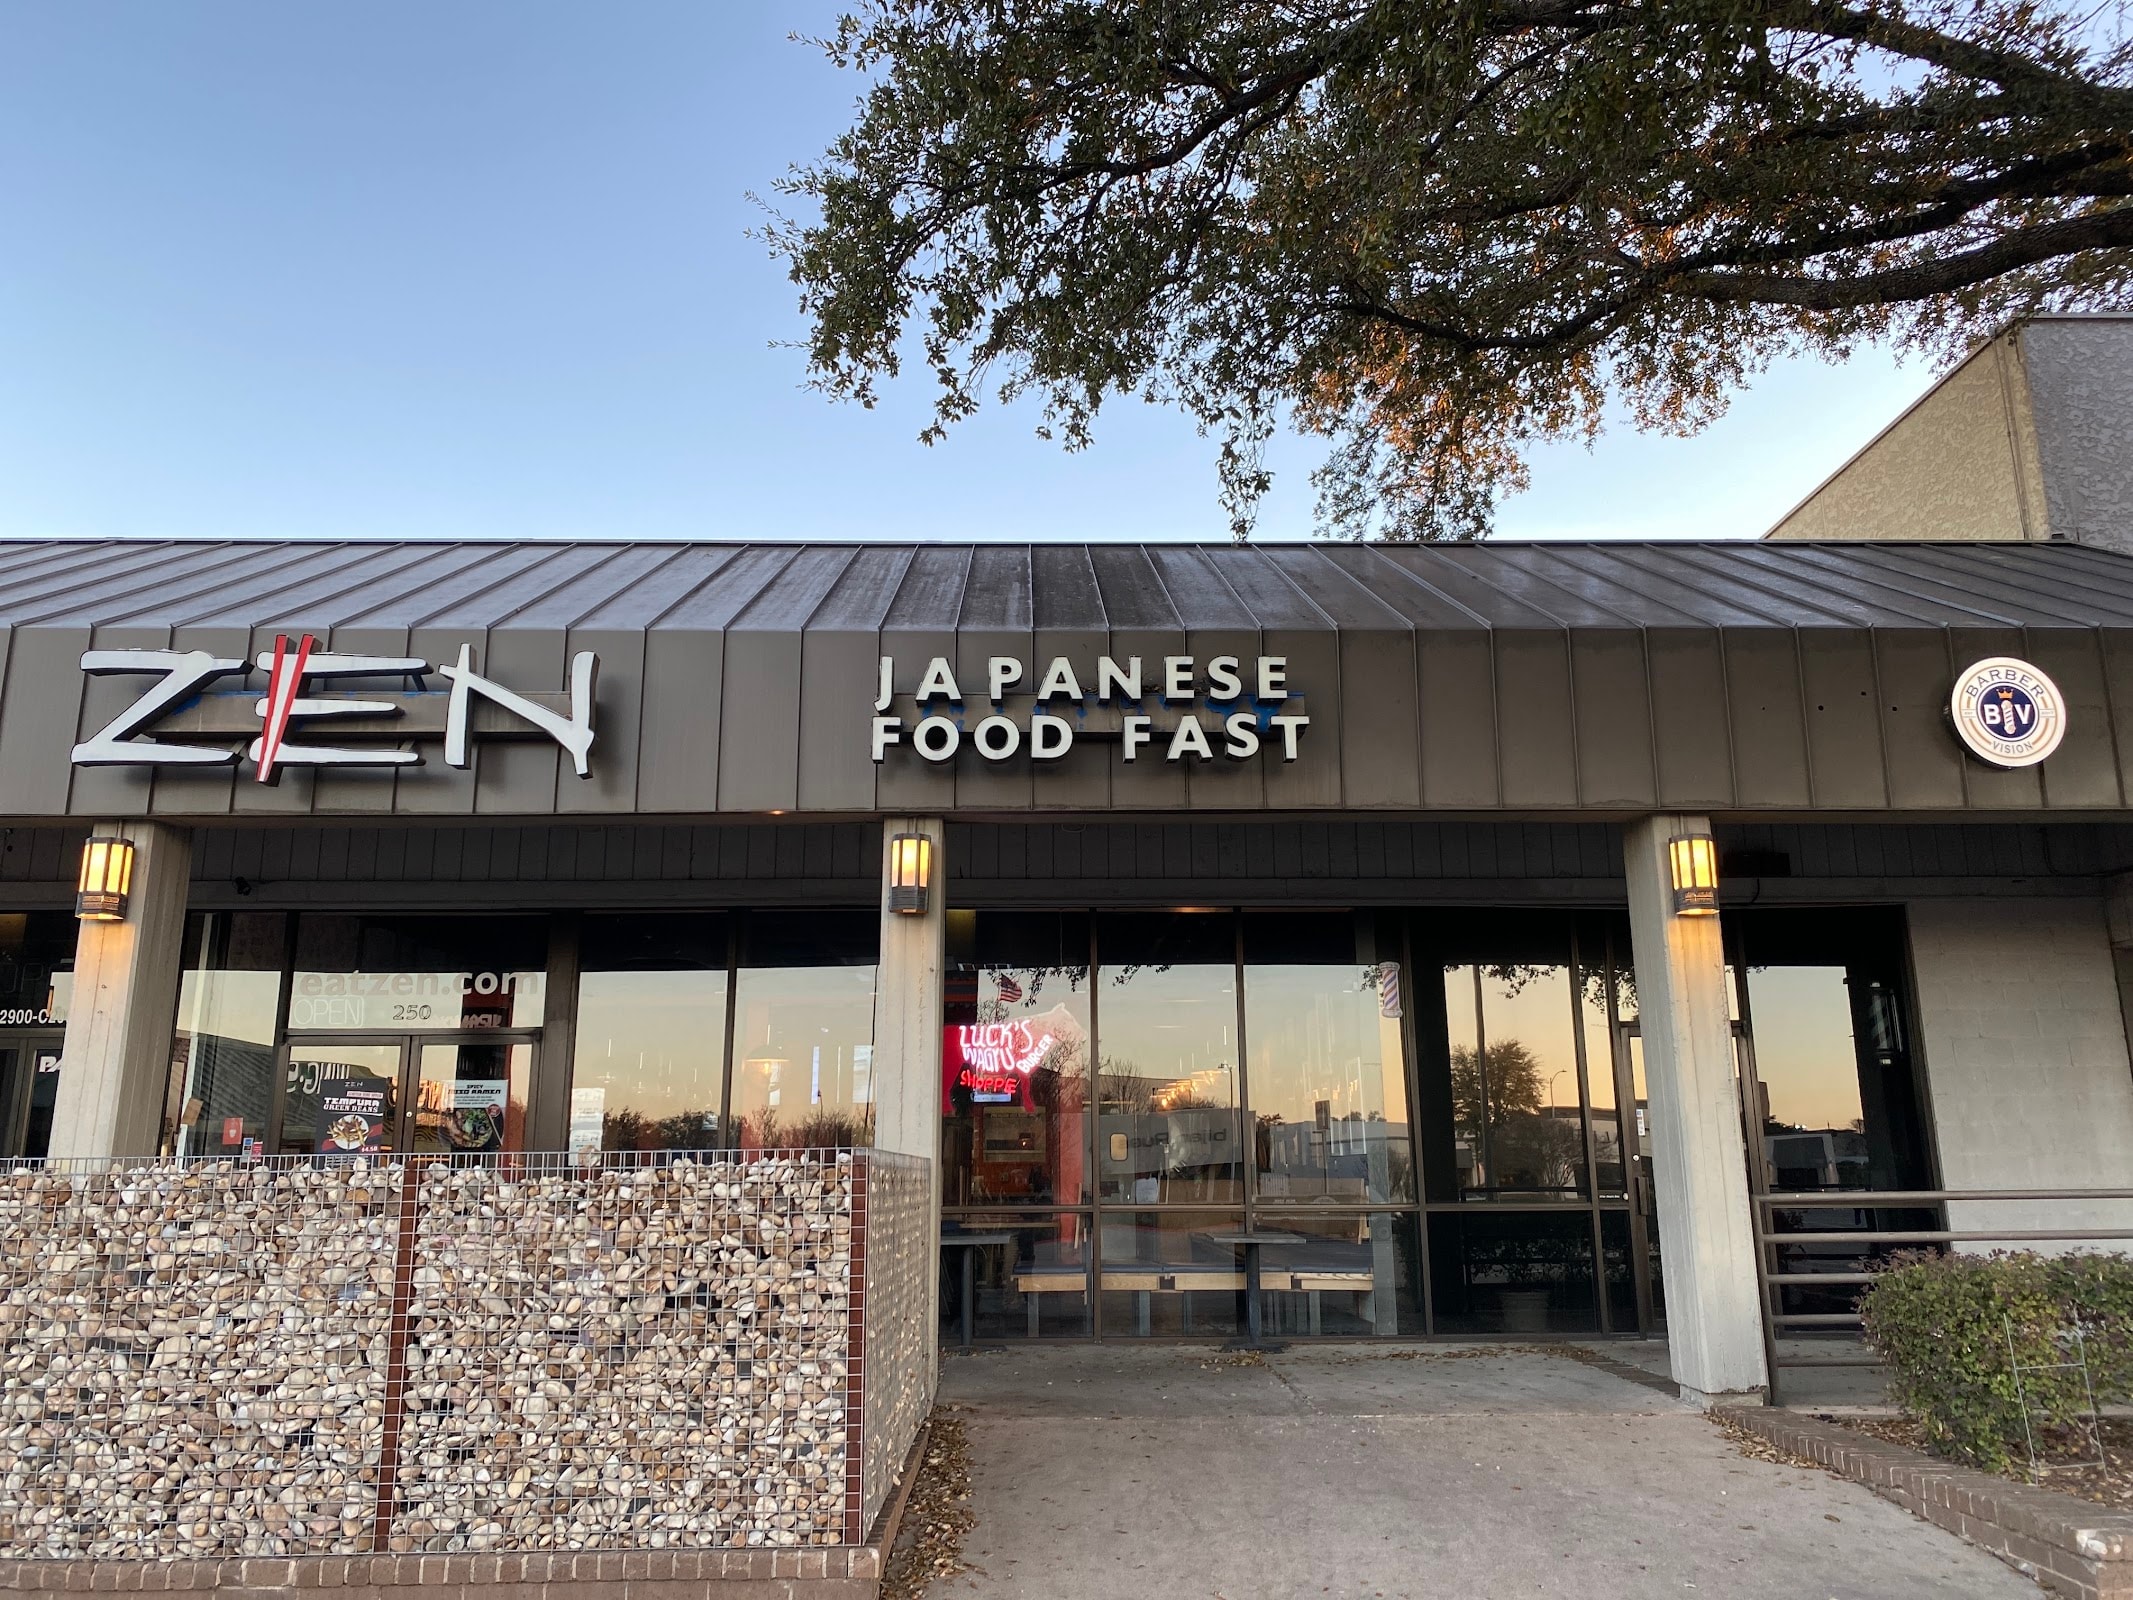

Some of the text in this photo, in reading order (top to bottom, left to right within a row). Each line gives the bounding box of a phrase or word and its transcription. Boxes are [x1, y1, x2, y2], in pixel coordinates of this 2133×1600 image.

[873, 655, 1289, 713] JAPANESE
[1966, 669, 2045, 698] BARBER
[71, 634, 600, 786] ZEN
[871, 712, 1310, 763] FOOD FAST
[1992, 740, 2035, 754] VISION
[300, 969, 539, 997] eatzen.com
[293, 998, 361, 1025] OPEN
[392, 1004, 432, 1021] 250
[959, 1019, 1034, 1054] LUCK'S
[962, 1046, 1016, 1073] WAGYU
[1015, 1033, 1054, 1074] BURGER
[959, 1069, 1018, 1094] SHOPPE
[323, 1097, 380, 1107] TEMPURA
